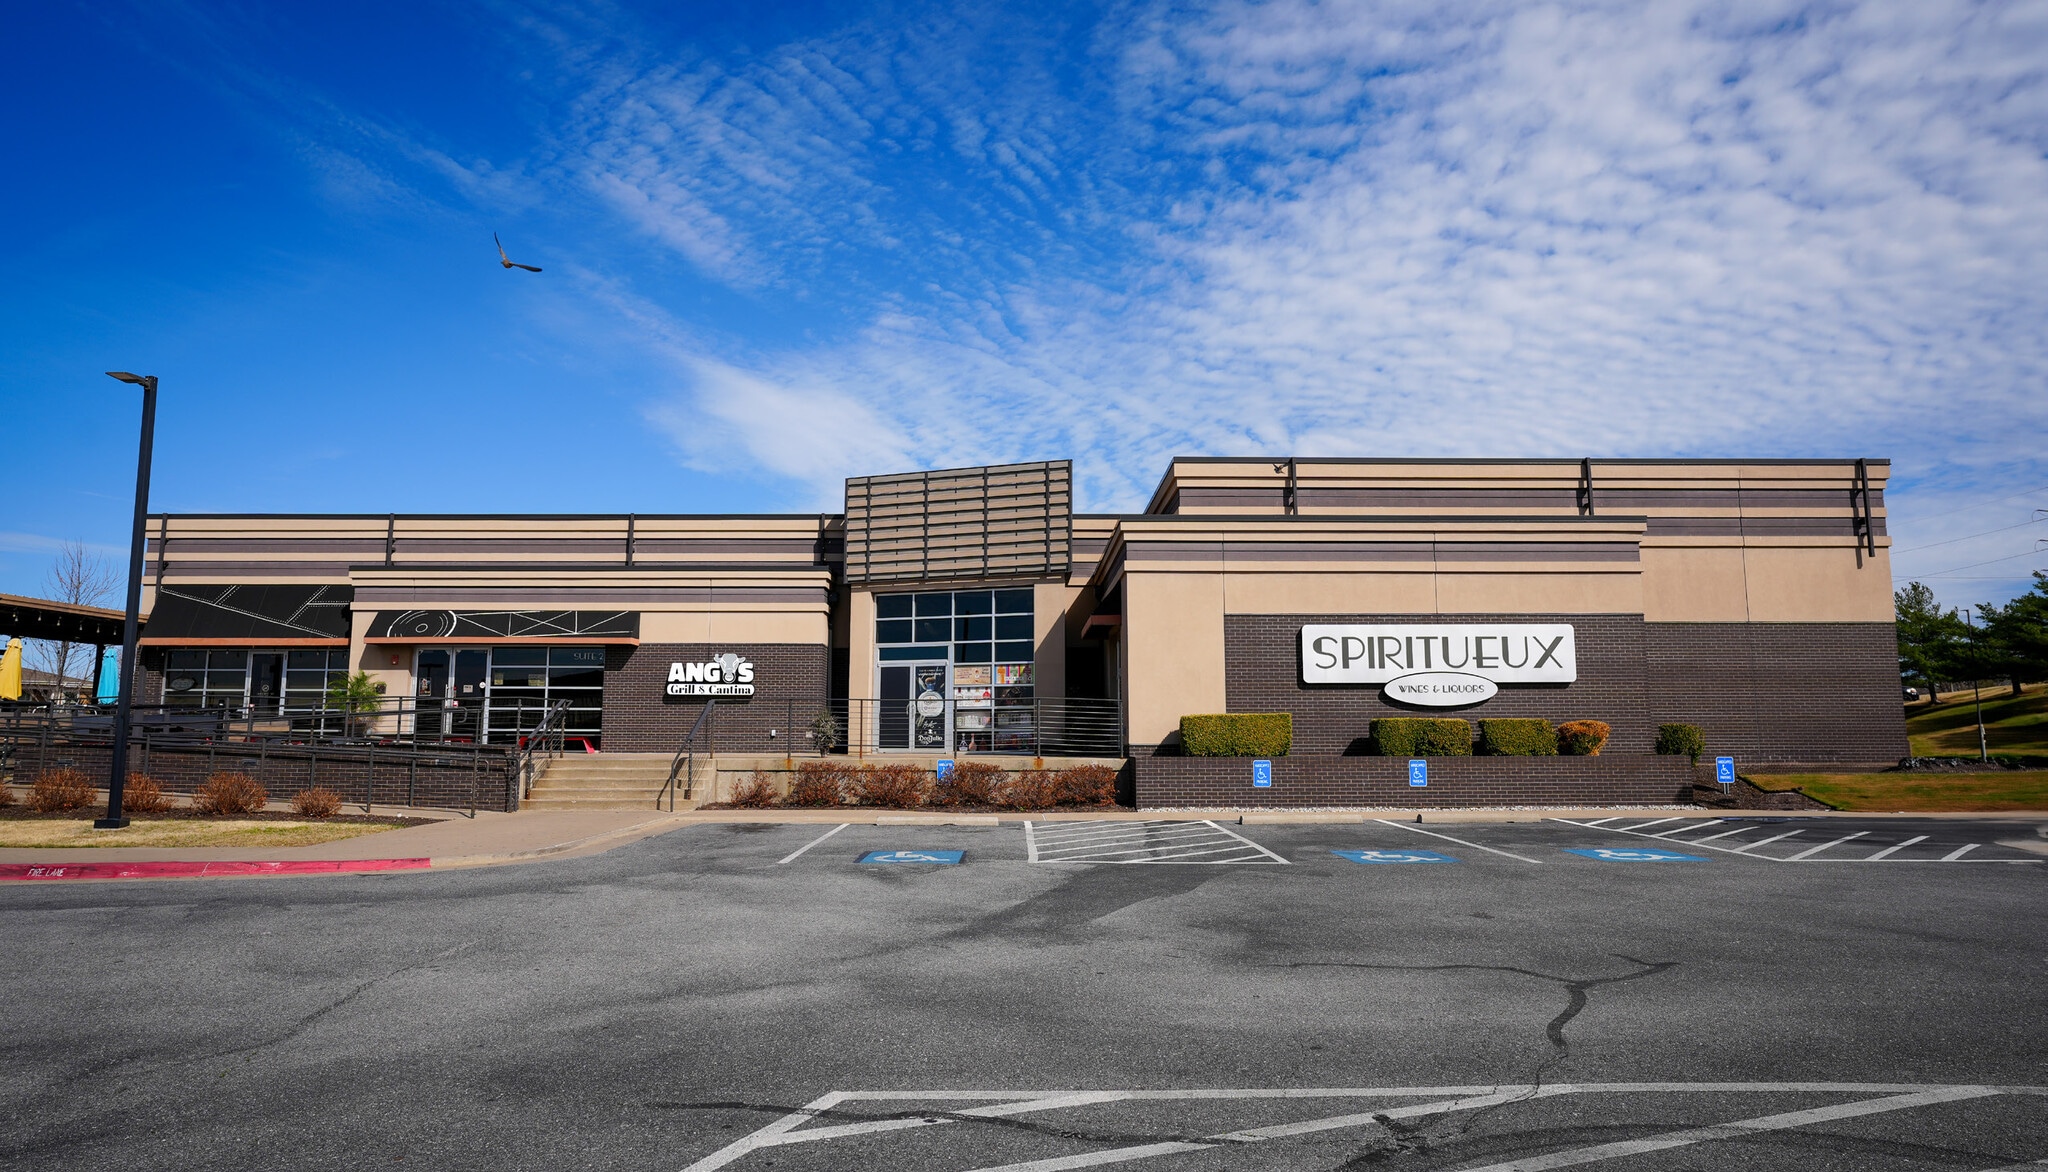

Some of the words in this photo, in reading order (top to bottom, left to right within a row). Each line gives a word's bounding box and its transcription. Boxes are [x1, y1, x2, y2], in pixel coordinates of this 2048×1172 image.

[573, 652, 597, 660] SUITE
[1312, 636, 1564, 669] SPIRITUEUX
[667, 662, 754, 683] ANGS
[670, 684, 695, 694] Grill
[698, 685, 705, 694] &
[708, 684, 751, 694] Cantina
[1398, 684, 1429, 693] WINES
[1433, 684, 1440, 693] &
[1442, 684, 1485, 694] LIQUORS
[27, 868, 46, 876] FIRE
[46, 867, 67, 877] LANE
